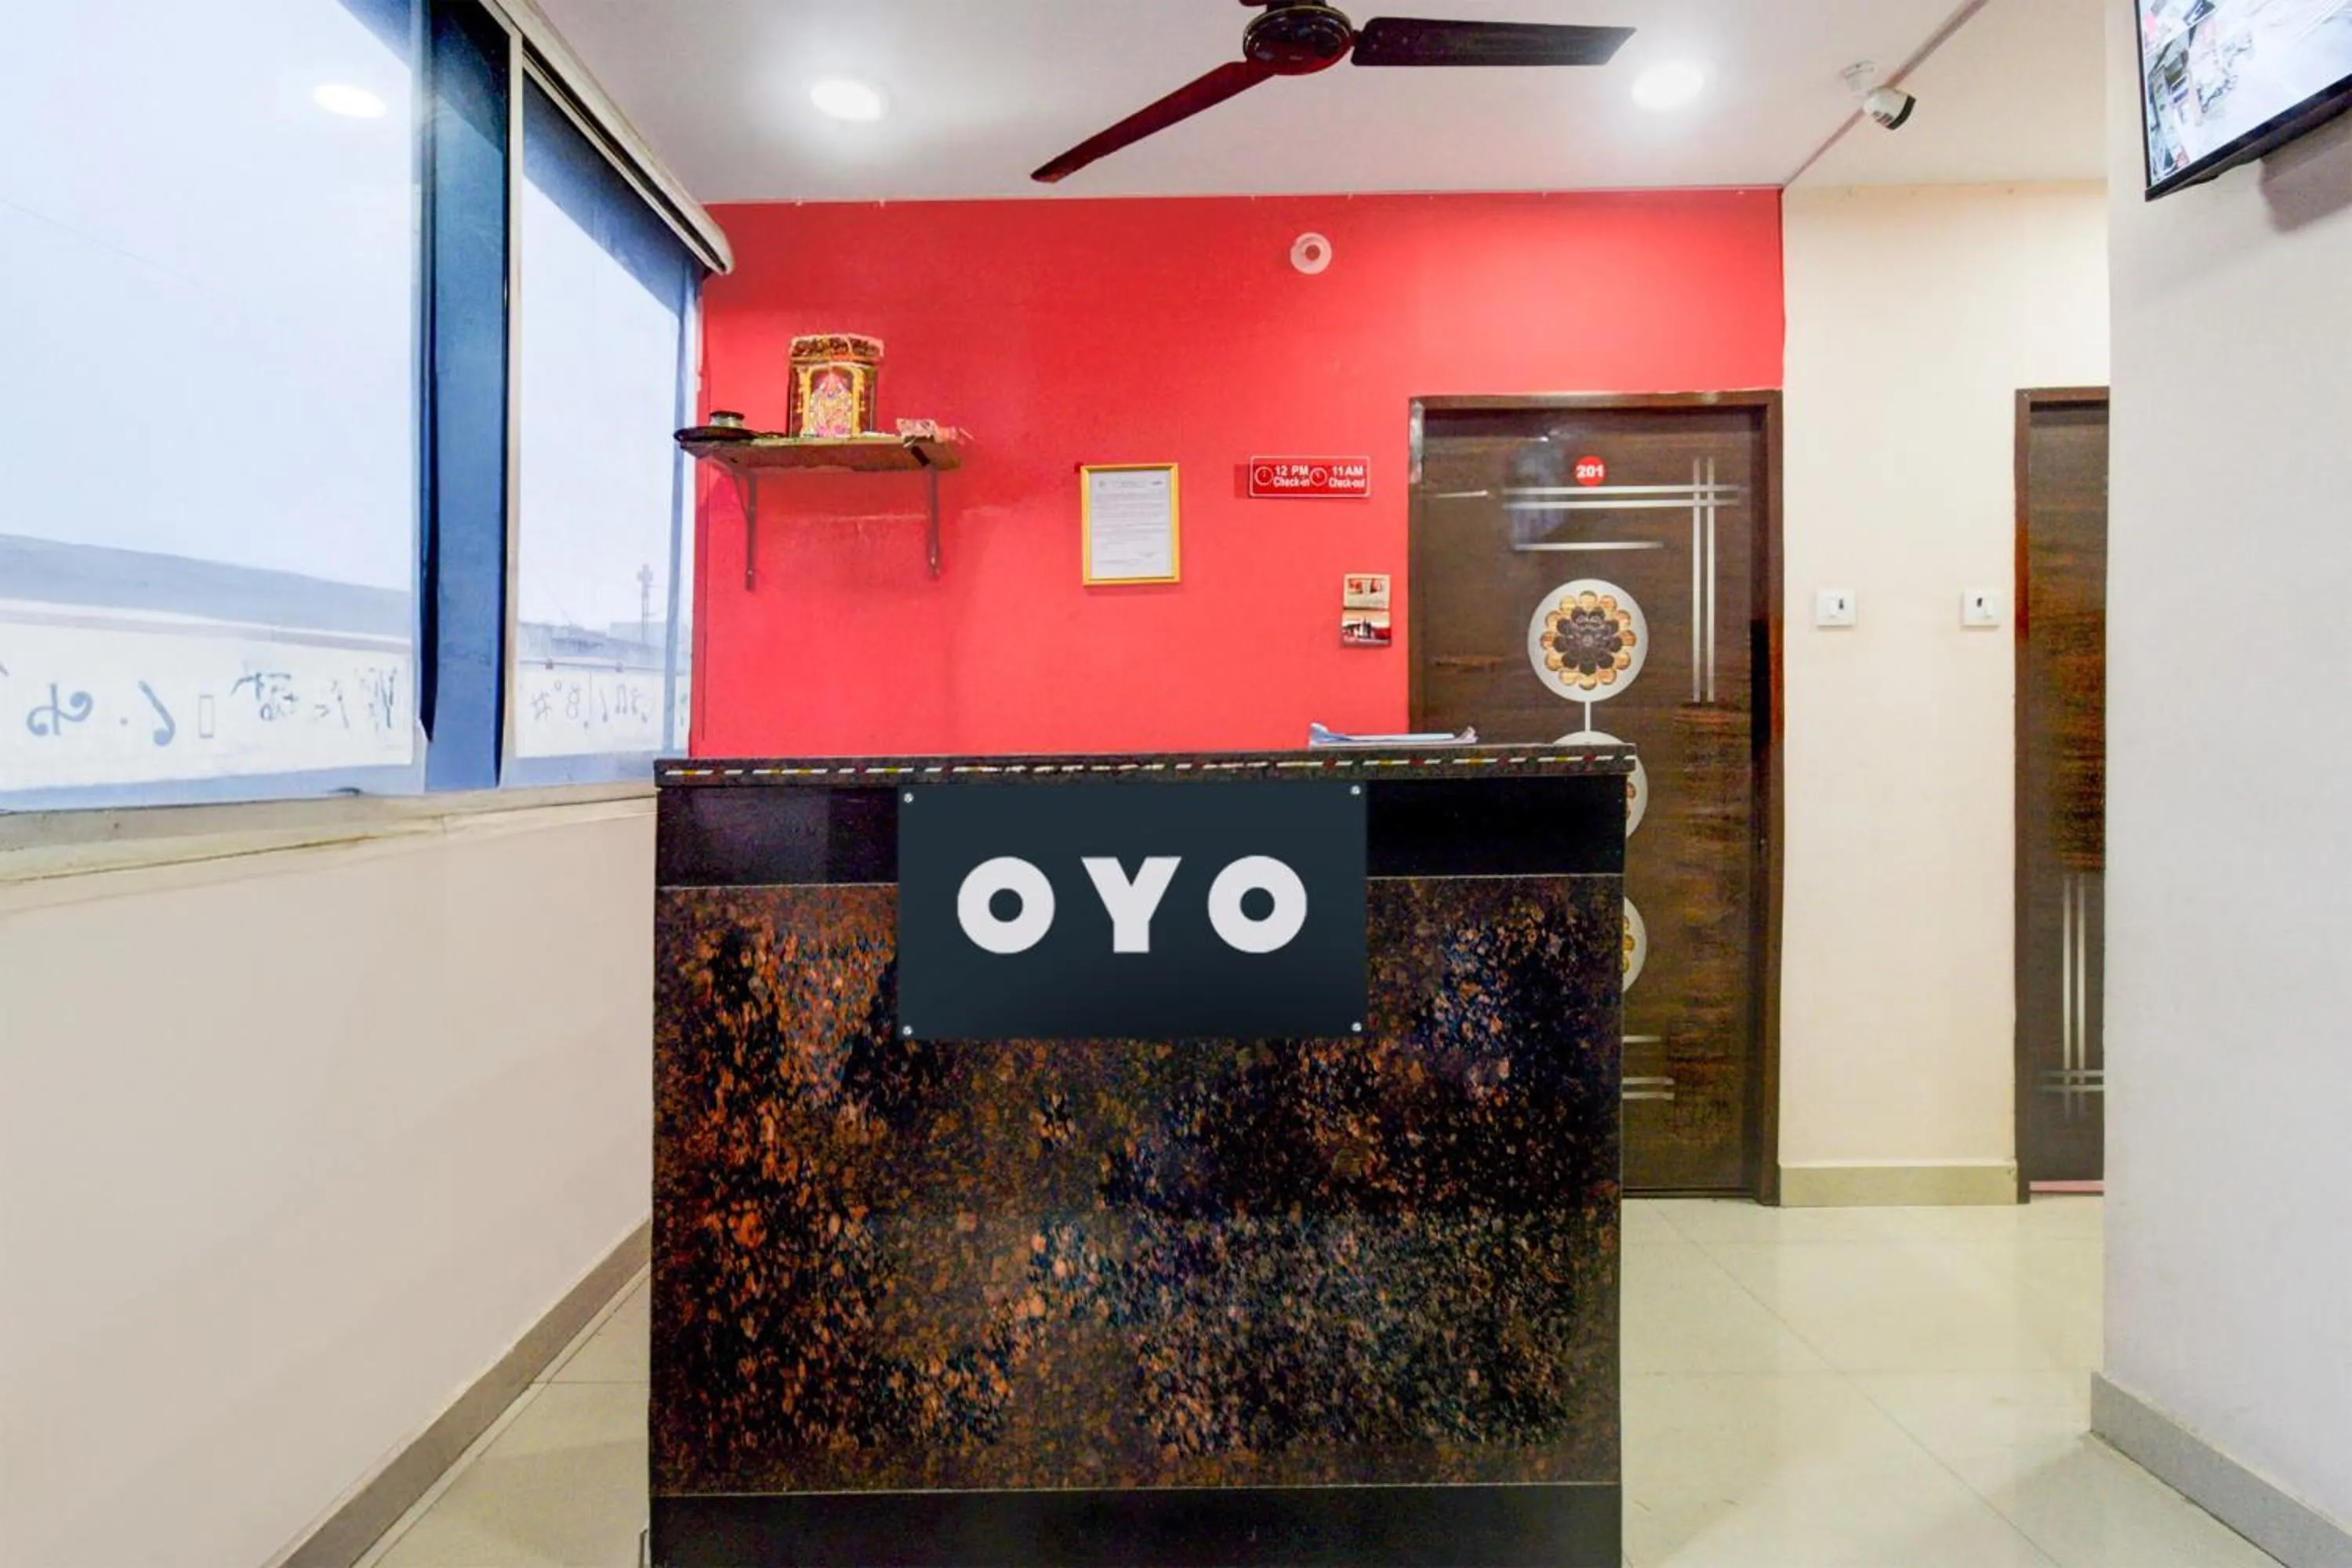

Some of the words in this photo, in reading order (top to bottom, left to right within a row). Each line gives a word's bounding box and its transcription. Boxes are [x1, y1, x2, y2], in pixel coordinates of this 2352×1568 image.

[1275, 465, 1288, 476] 12
[1291, 465, 1309, 476] PM
[1576, 464, 1604, 478] 201
[956, 855, 1308, 954] OYO
